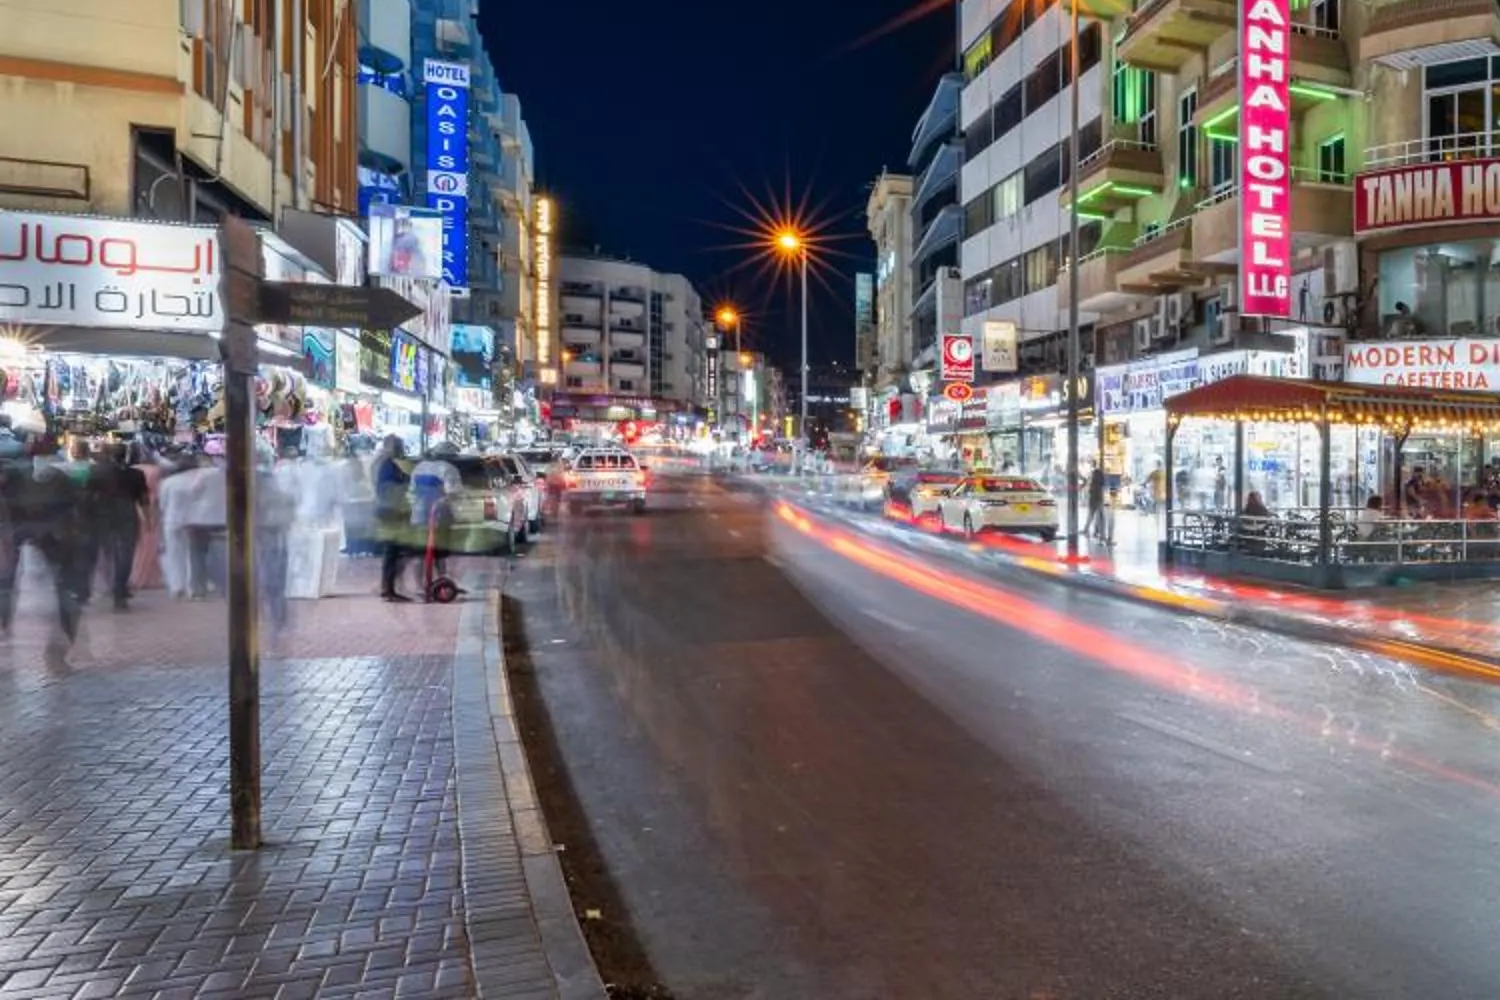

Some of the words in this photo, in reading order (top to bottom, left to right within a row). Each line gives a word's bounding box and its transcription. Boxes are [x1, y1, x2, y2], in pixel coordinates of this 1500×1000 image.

[427, 63, 468, 83] HOTEL
[436, 87, 457, 169] OASIS
[1248, 127, 1285, 267] HOTEL
[1363, 168, 1454, 227] TANHA
[95, 284, 213, 322] لتجارة
[1347, 344, 1456, 369] MODERN
[1383, 371, 1489, 390] CAFETERIA
